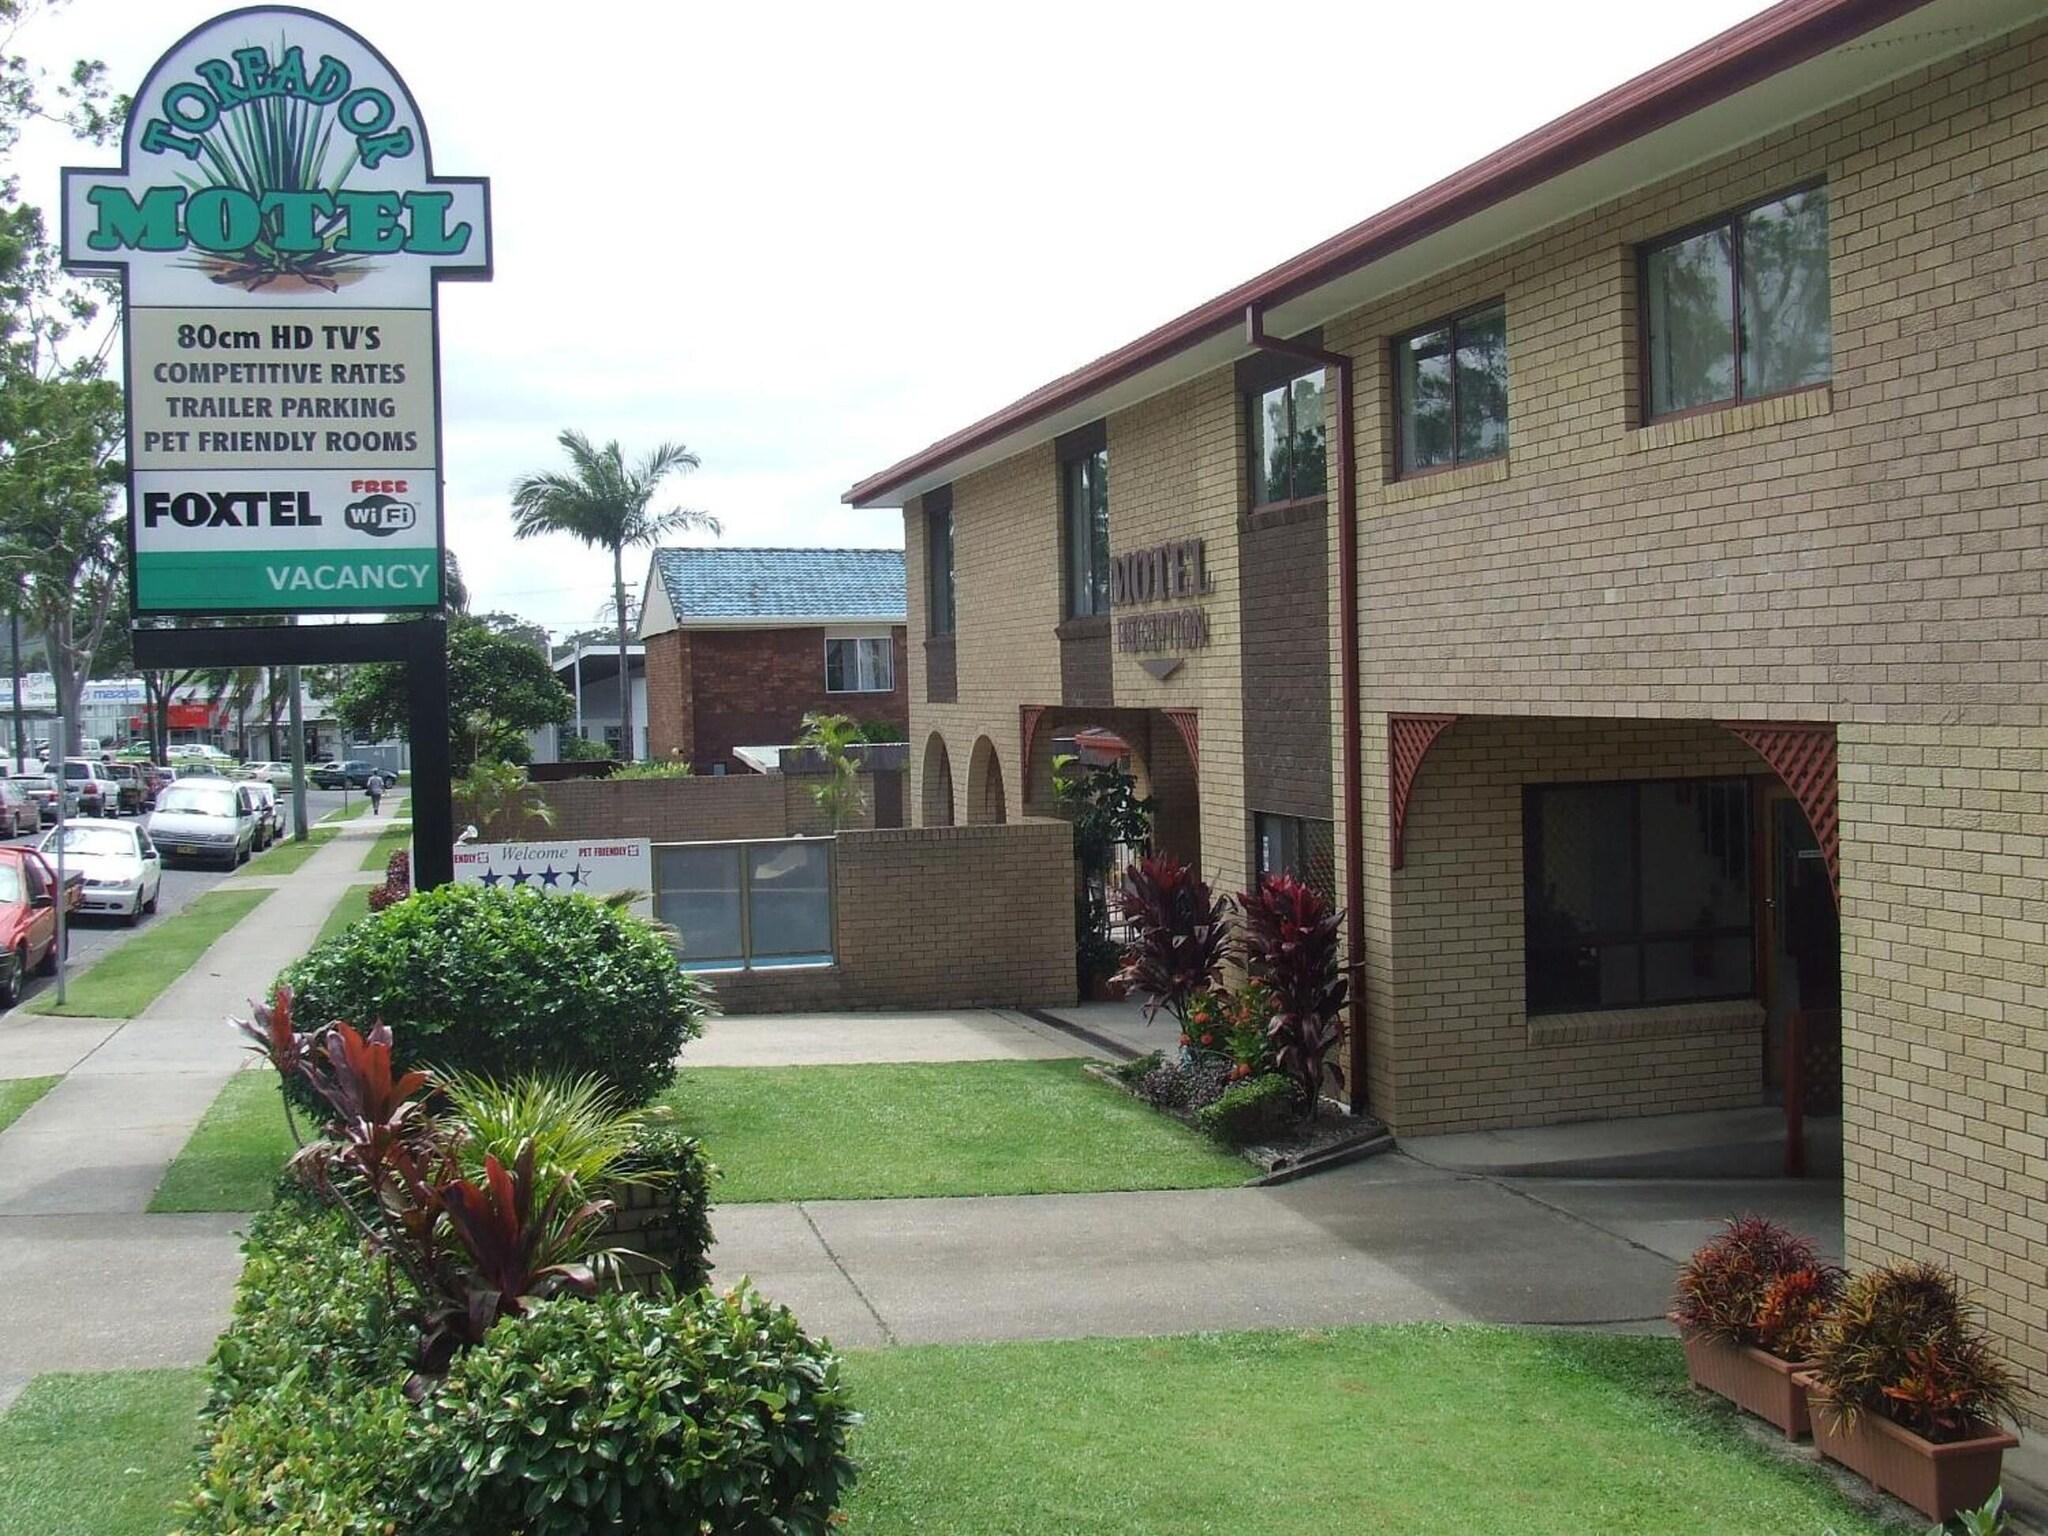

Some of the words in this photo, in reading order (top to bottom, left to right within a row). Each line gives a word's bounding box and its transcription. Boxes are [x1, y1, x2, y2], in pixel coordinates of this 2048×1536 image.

[140, 46, 415, 170] TOREADOR
[87, 185, 472, 255] MOTEL
[177, 324, 260, 350] 80cm
[271, 325, 313, 349] HD
[321, 325, 381, 350] TV'S
[154, 362, 322, 384] COMPETITIVE
[331, 363, 406, 384] RATES
[166, 397, 273, 418] TRAILER
[281, 397, 396, 418] PARKING
[144, 431, 190, 452] PET
[199, 431, 318, 452] FRIENDLY
[326, 431, 418, 452] ROOMS
[351, 480, 408, 493] FREE
[144, 491, 322, 527] FOXTEL
[266, 564, 430, 590] VACANCY
[1111, 537, 1216, 607] MOTEL
[501, 846, 569, 861] Welcome
